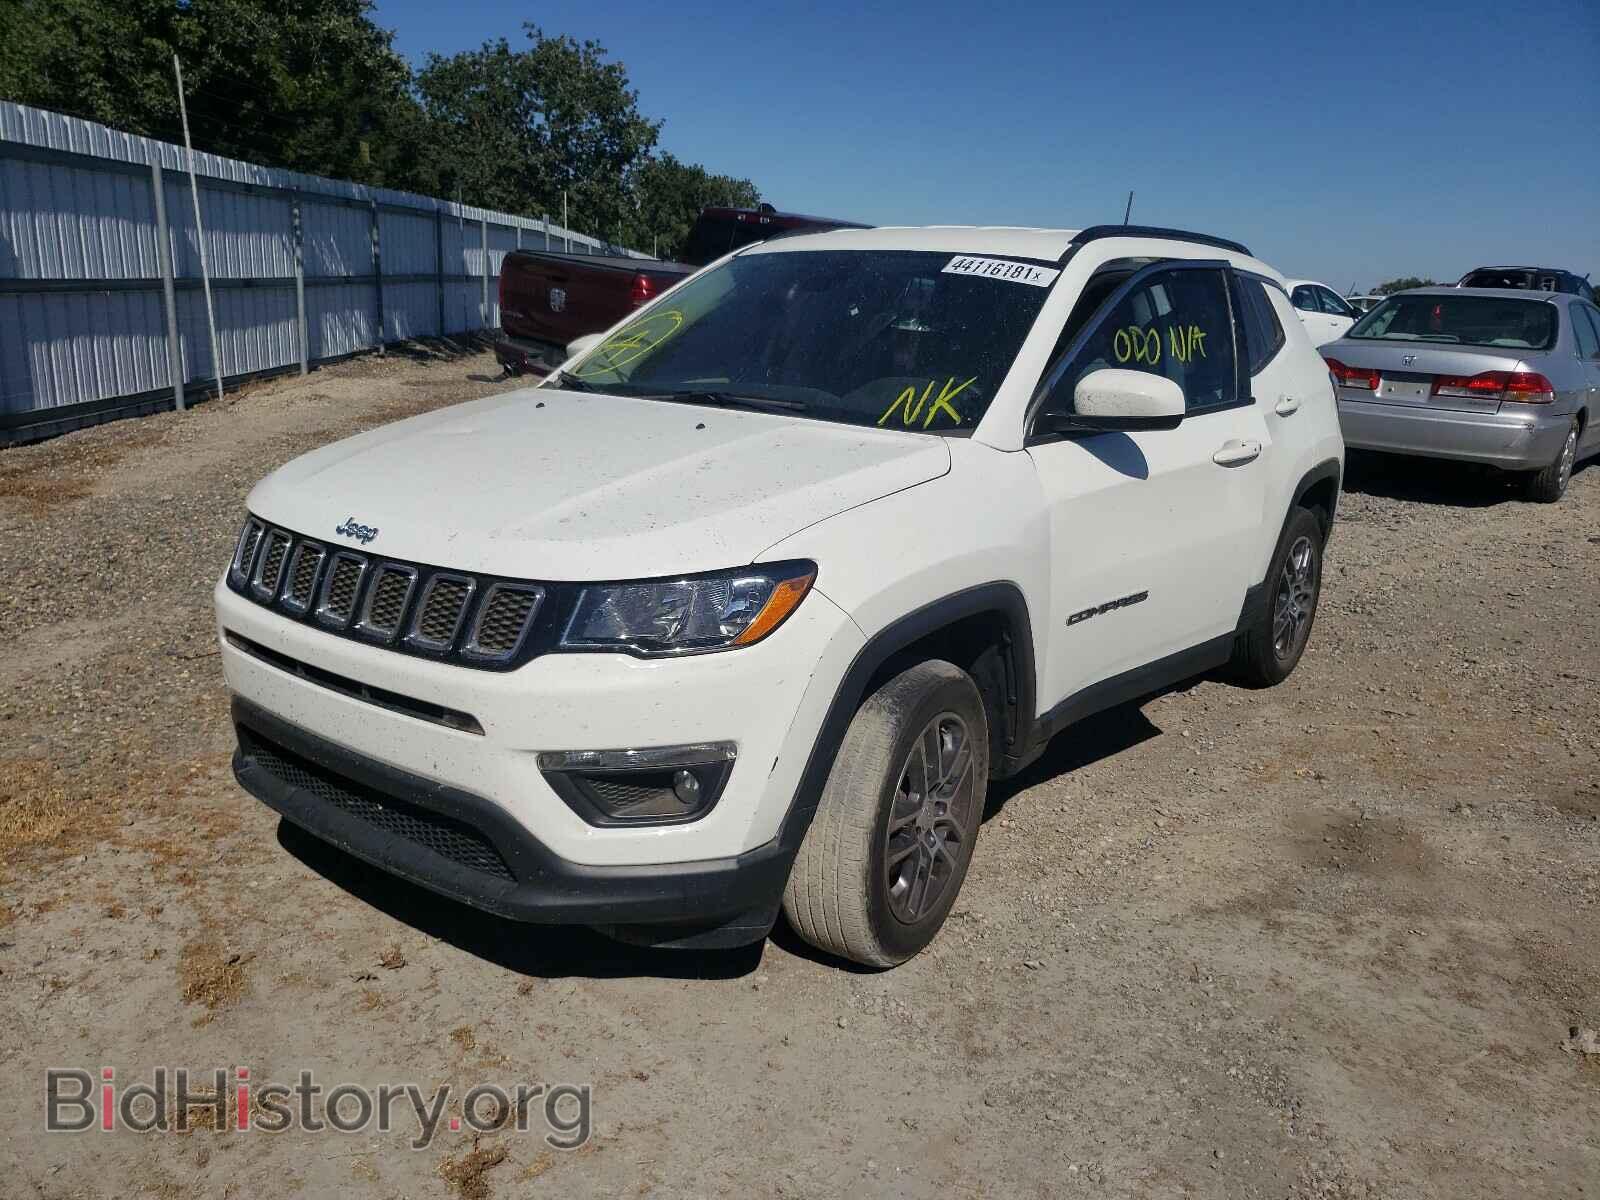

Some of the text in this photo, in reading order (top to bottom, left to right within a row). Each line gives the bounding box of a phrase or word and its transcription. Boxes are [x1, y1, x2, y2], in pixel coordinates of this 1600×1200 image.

[1114, 325, 1207, 365] ODO N/A
[877, 376, 978, 429] NK
[336, 517, 379, 545] Jeep
[1066, 590, 1149, 626] COMPASS
